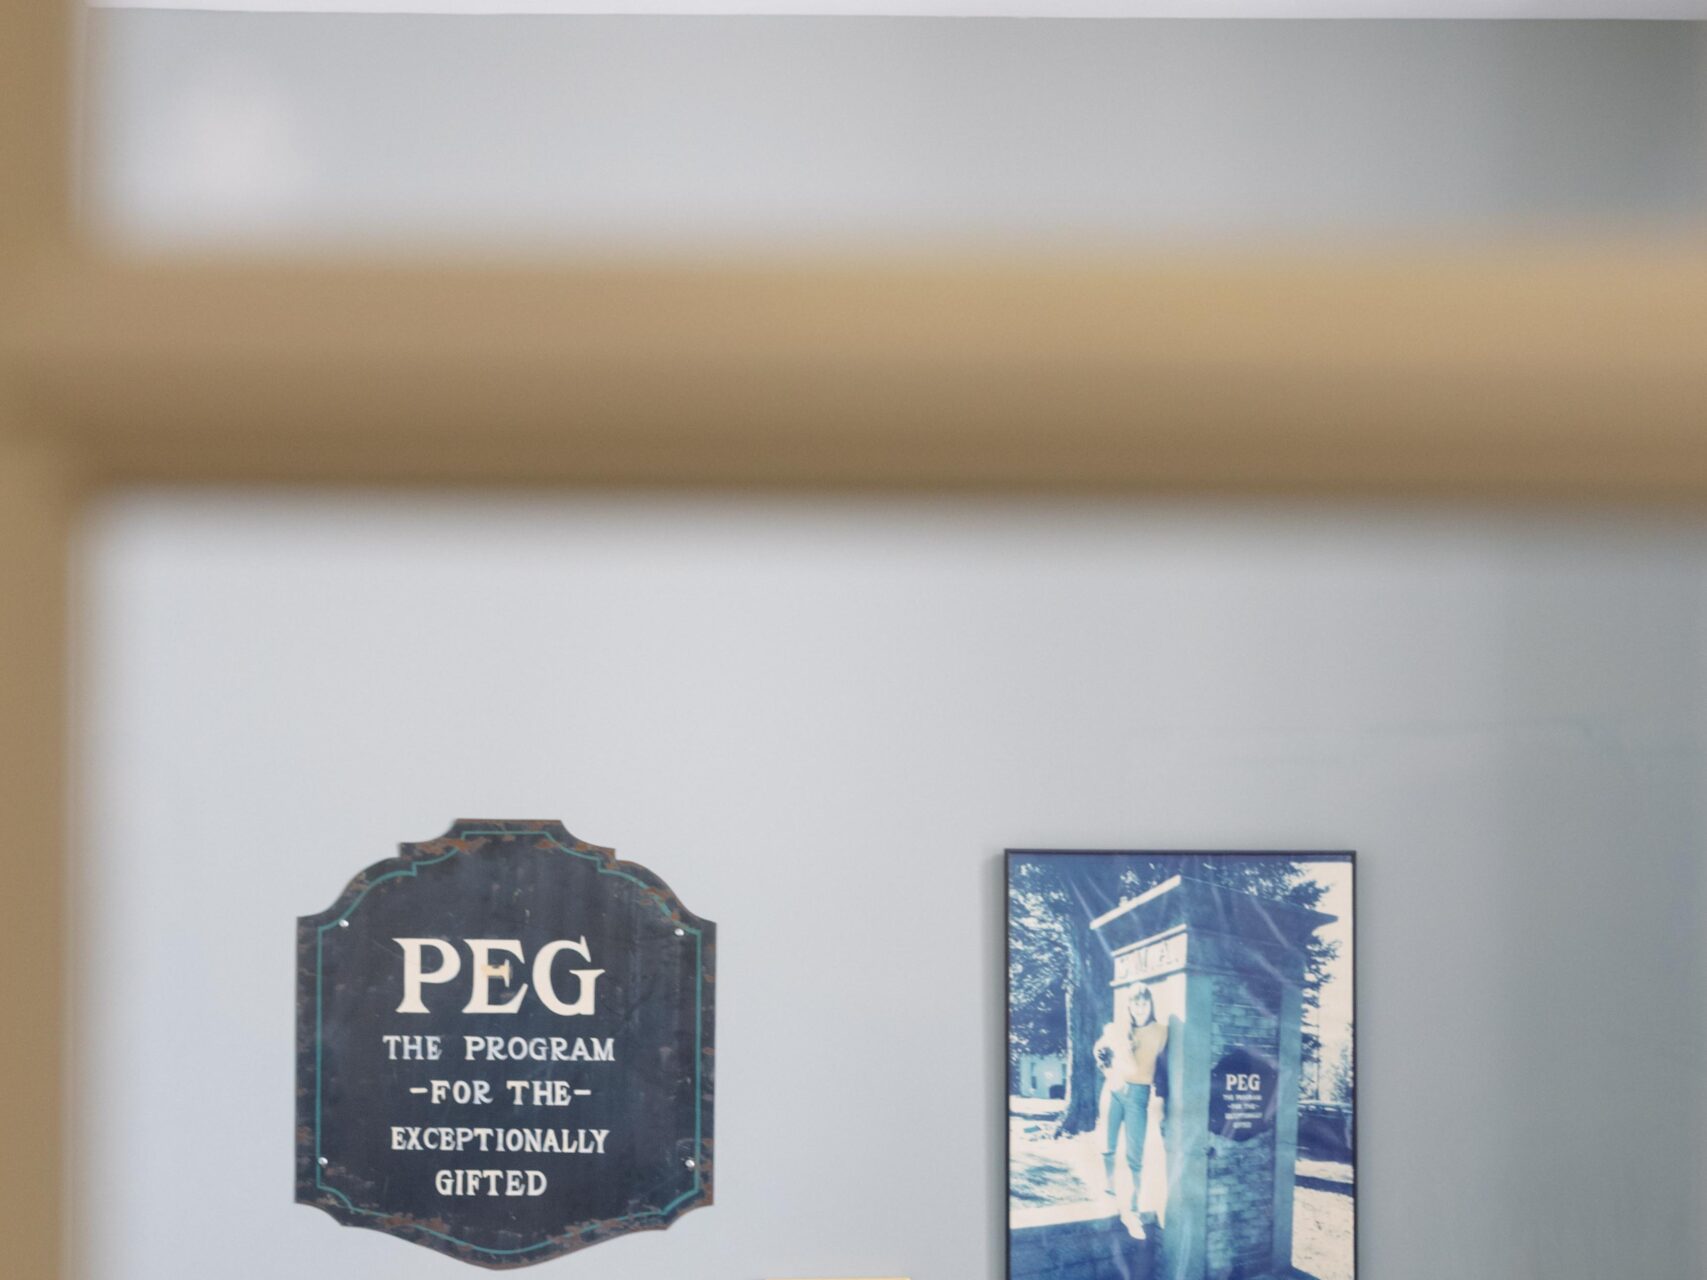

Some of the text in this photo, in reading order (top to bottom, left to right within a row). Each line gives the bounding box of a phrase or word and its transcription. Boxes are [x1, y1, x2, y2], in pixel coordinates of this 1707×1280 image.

[392, 935, 605, 1016] PEG
[382, 1035, 615, 1061] THE PROGRAM
[1225, 1074, 1261, 1092] PEG
[391, 1127, 610, 1153] EXCEPTIONALLY
[435, 1170, 547, 1196] GIFTED
